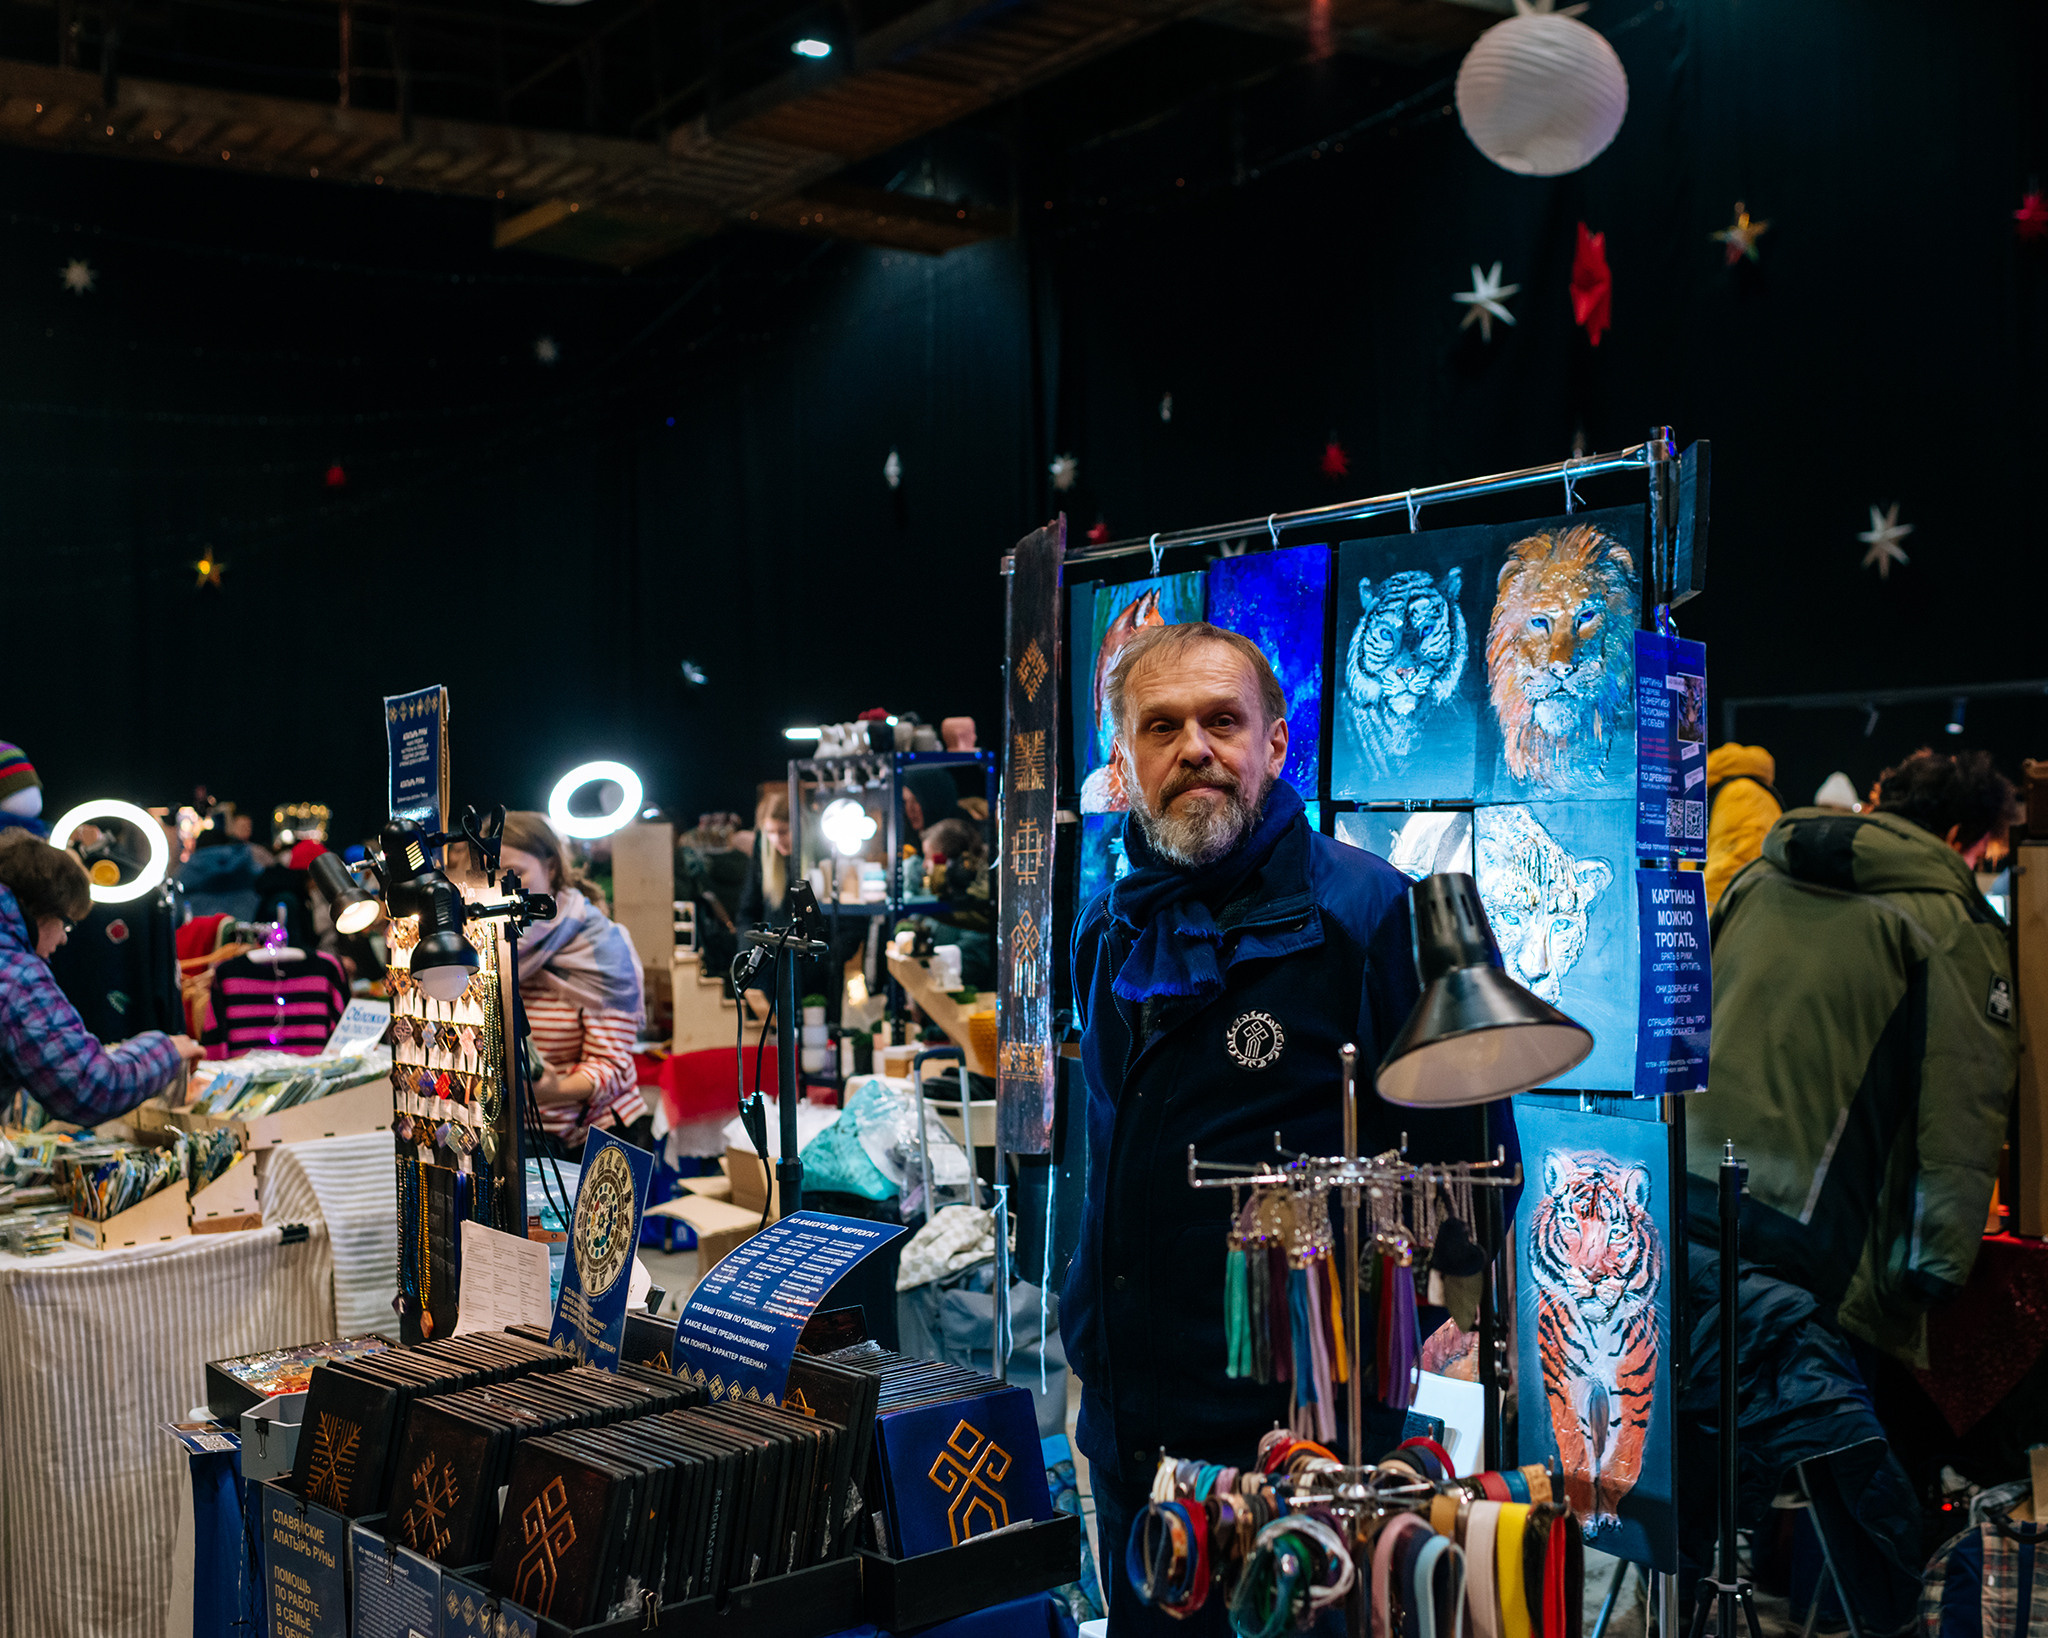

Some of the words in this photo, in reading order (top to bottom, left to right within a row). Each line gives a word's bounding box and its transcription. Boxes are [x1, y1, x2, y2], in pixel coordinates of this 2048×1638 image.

[1640, 676, 1663, 688] КАРТИНЫ
[1652, 888, 1696, 905] КАРТИНЫ
[1658, 911, 1693, 926] МОЖНО
[1655, 932, 1698, 949] ТРОГАТЬ,
[798, 1218, 827, 1229] КАКОГО
[826, 1223, 842, 1231] ВЫ
[841, 1226, 880, 1239] ЧЕРТОГА?
[691, 1302, 703, 1311] КТО
[702, 1305, 716, 1315] ВАШ
[714, 1309, 733, 1320] ТОТЕМ
[731, 1314, 742, 1323] ПО
[740, 1317, 777, 1334] РОЖДЕНИЮ?
[684, 1318, 702, 1330] КАКОЕ
[701, 1323, 718, 1335] ВАШЕ
[717, 1328, 770, 1351] ПРЕДНАЗНАЧЕНИЕ?
[680, 1335, 691, 1345] КАК
[690, 1339, 712, 1352] ПОНЯТЬ
[711, 1345, 739, 1361] ХАРАКТЕР
[739, 1355, 768, 1371] РЕБЕНКА?
[273, 1528, 311, 1557] АЛАТЫРЬ
[312, 1545, 336, 1569] РУНЫ
[274, 1565, 311, 1595] ПОМОЩЬ
[275, 1584, 287, 1601] ПО
[288, 1590, 322, 1621] РАБОТЕ,
[276, 1602, 282, 1617] В
[283, 1607, 314, 1636] СЕМЬЕ,
[277, 1621, 283, 1635] В
